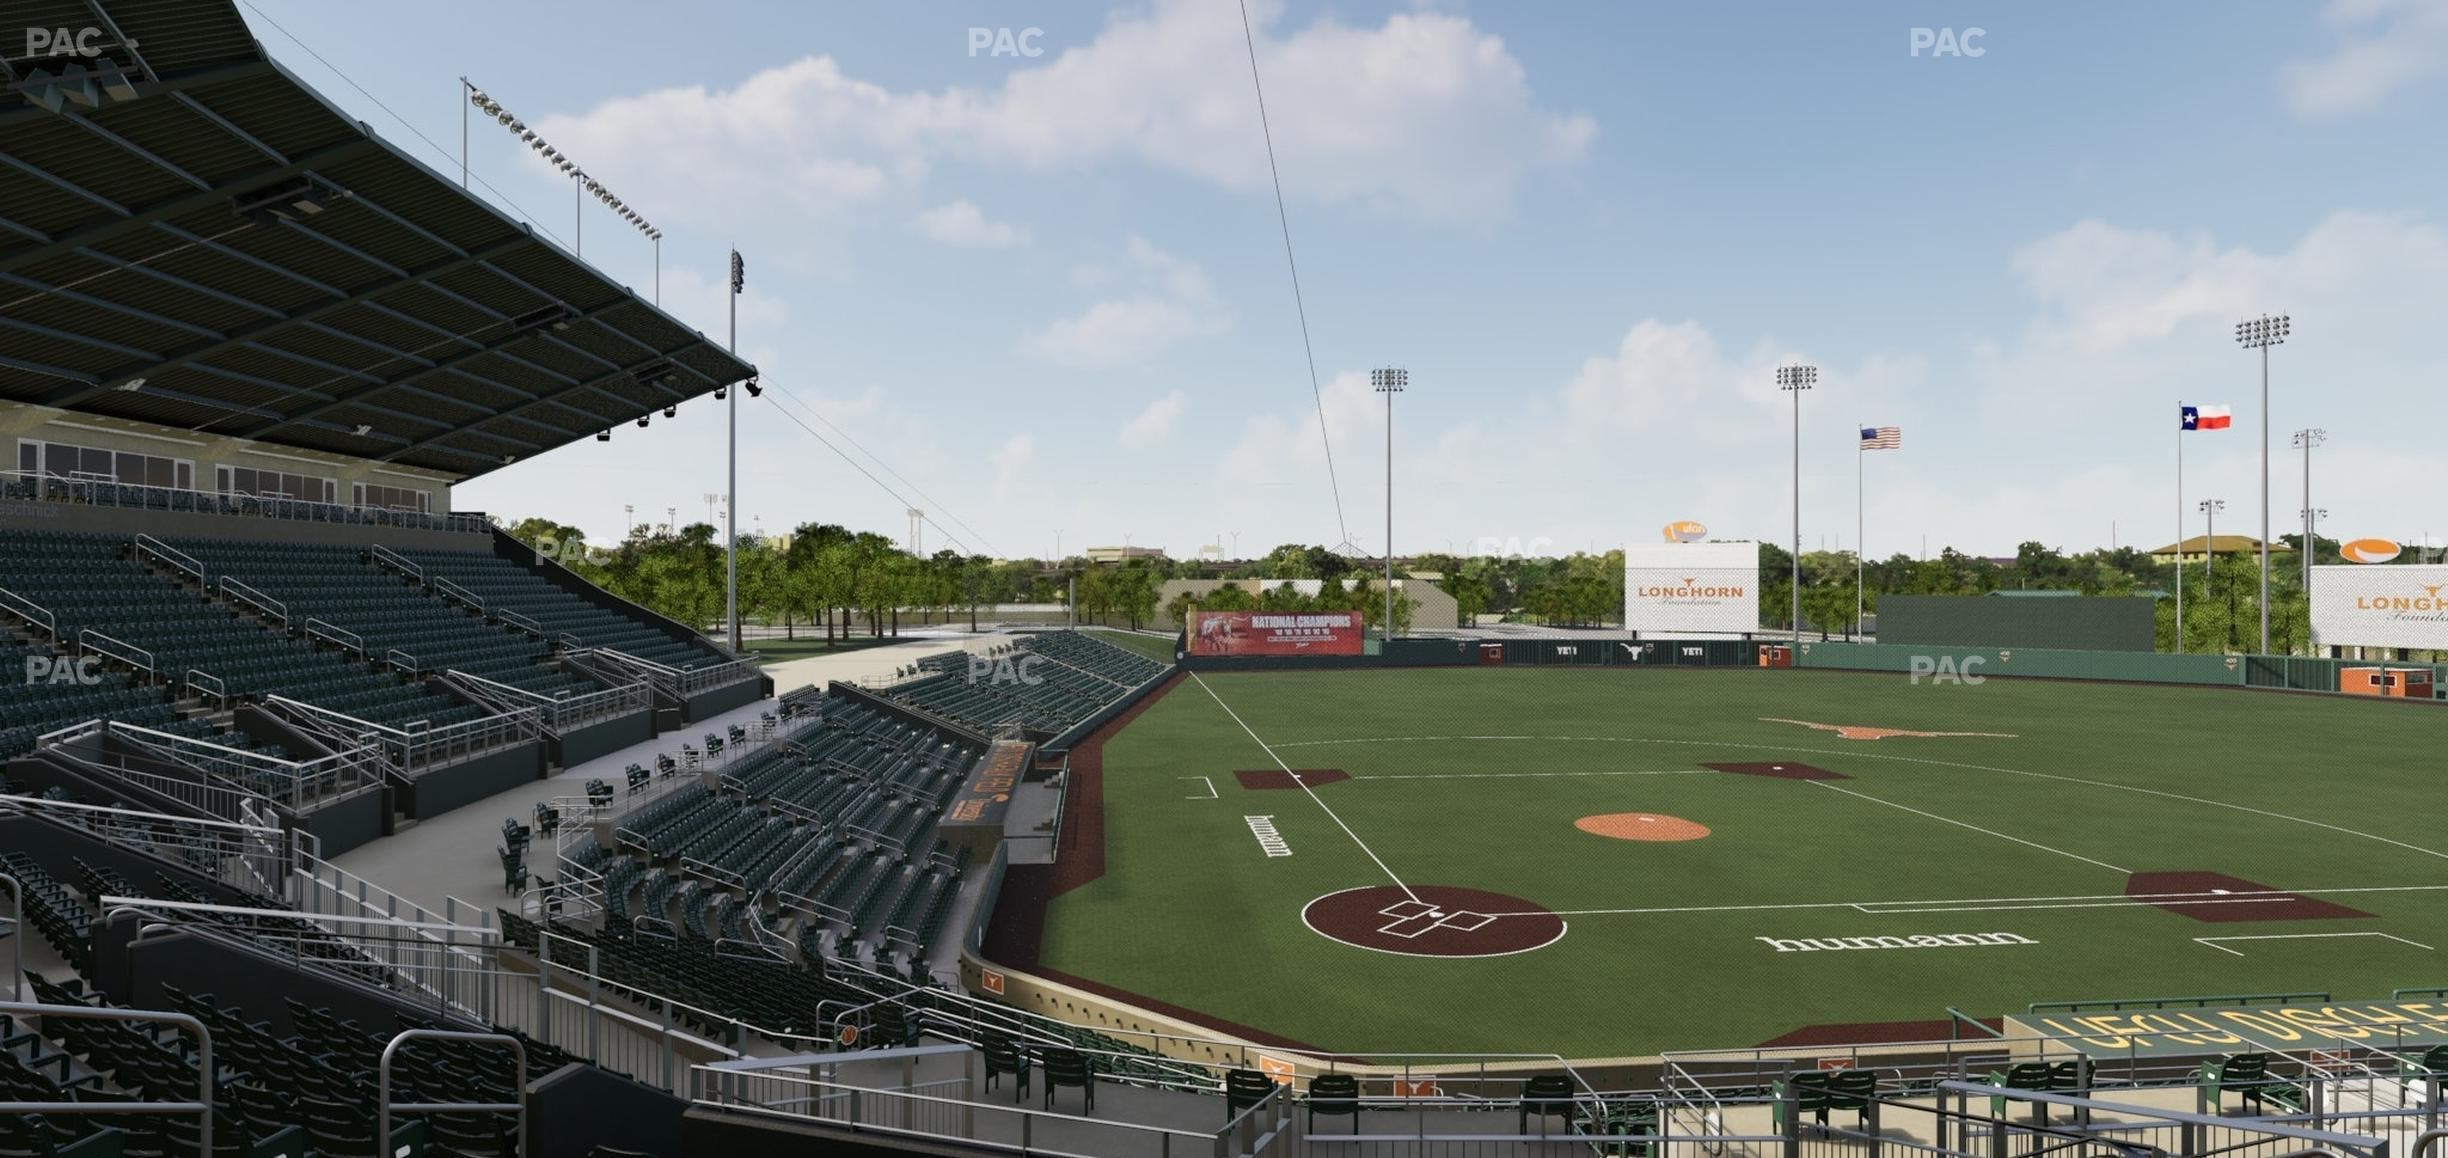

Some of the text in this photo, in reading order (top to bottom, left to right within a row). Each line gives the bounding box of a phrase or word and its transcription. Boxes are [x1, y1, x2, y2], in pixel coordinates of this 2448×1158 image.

[1638, 587, 1744, 598] LONGHORN
[1252, 615, 1351, 629] NATIONAL CHAMPIONS
[1682, 646, 1703, 656] YETI
[1243, 814, 1294, 858] humann
[1754, 932, 2040, 952] humann
[2041, 1013, 2242, 1049] UFCU
